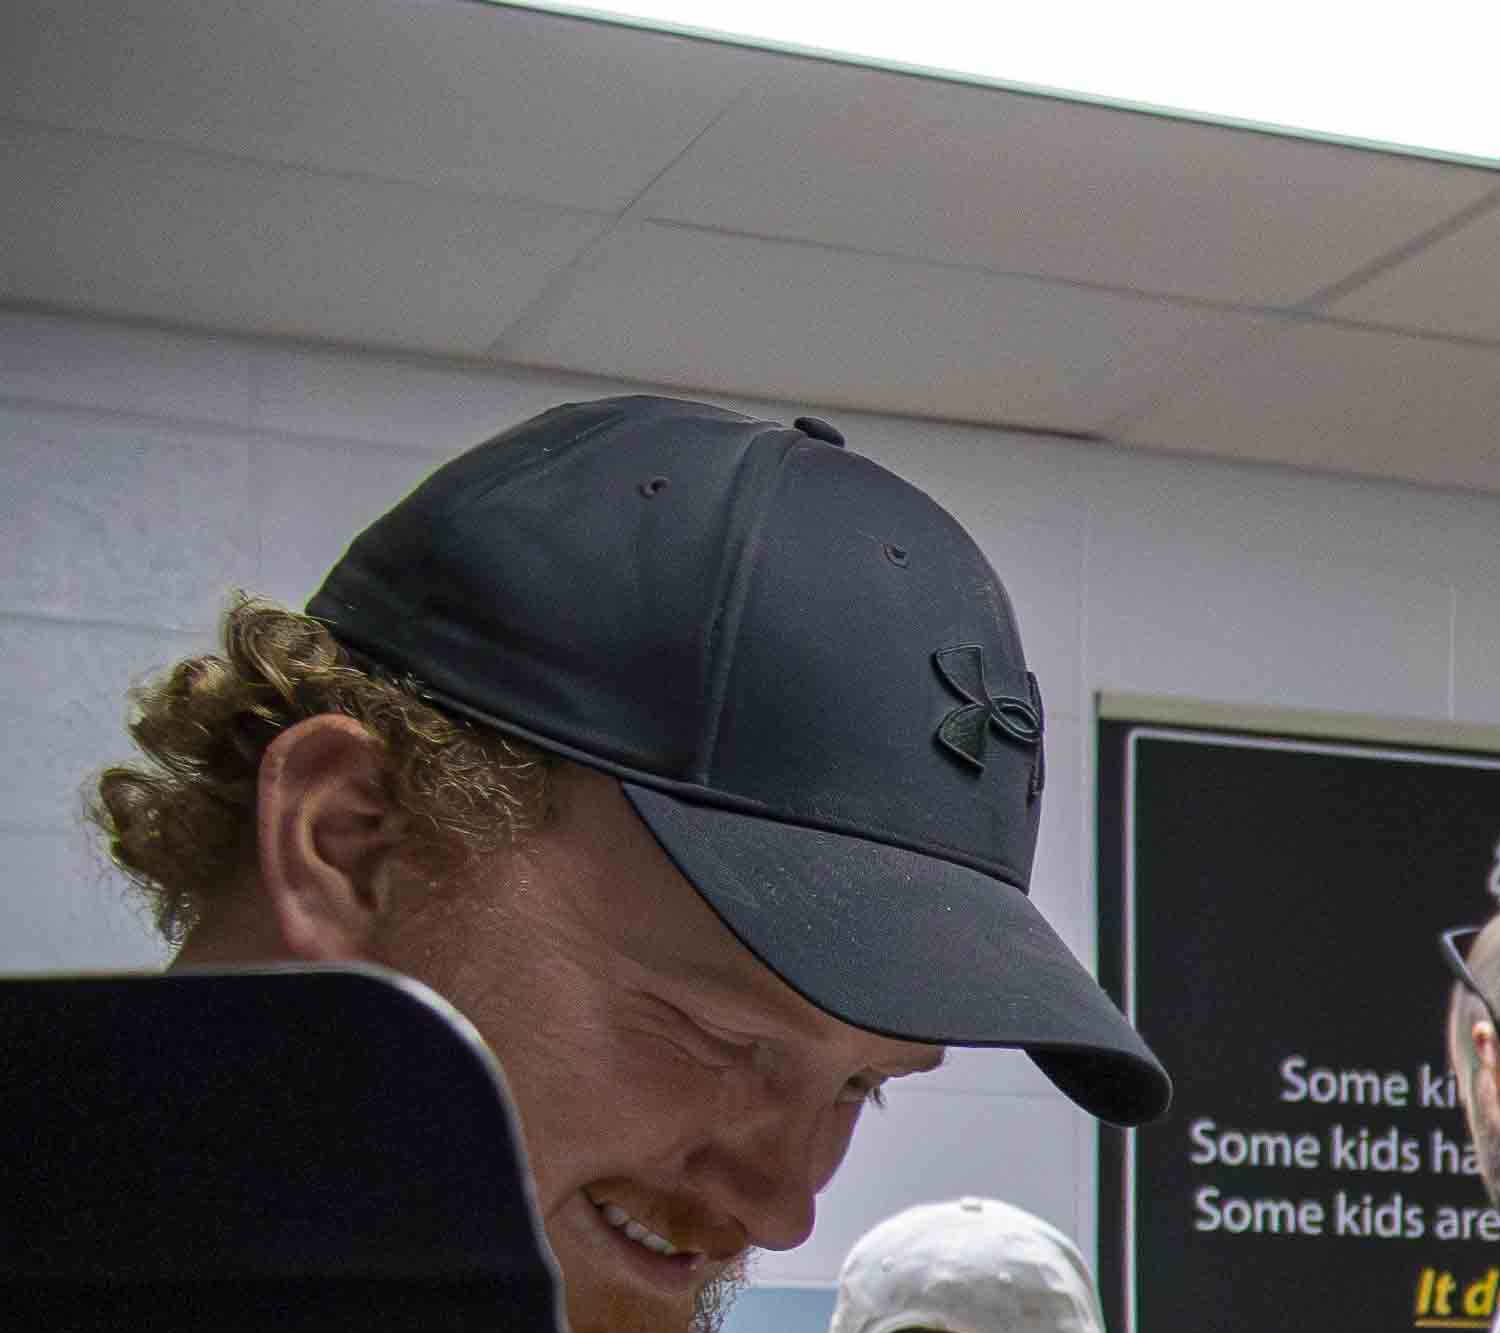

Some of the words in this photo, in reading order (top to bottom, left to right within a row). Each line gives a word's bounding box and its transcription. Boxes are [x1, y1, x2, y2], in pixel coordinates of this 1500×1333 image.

[1280, 1055, 1408, 1106] Some
[1420, 1063, 1457, 1108] ki
[1190, 1118, 1321, 1169] Some
[1332, 1125, 1420, 1173] kids
[1432, 1131, 1480, 1175] ha
[1195, 1186, 1324, 1236] Some
[1336, 1193, 1424, 1239] kids
[1415, 1268, 1456, 1316] It
